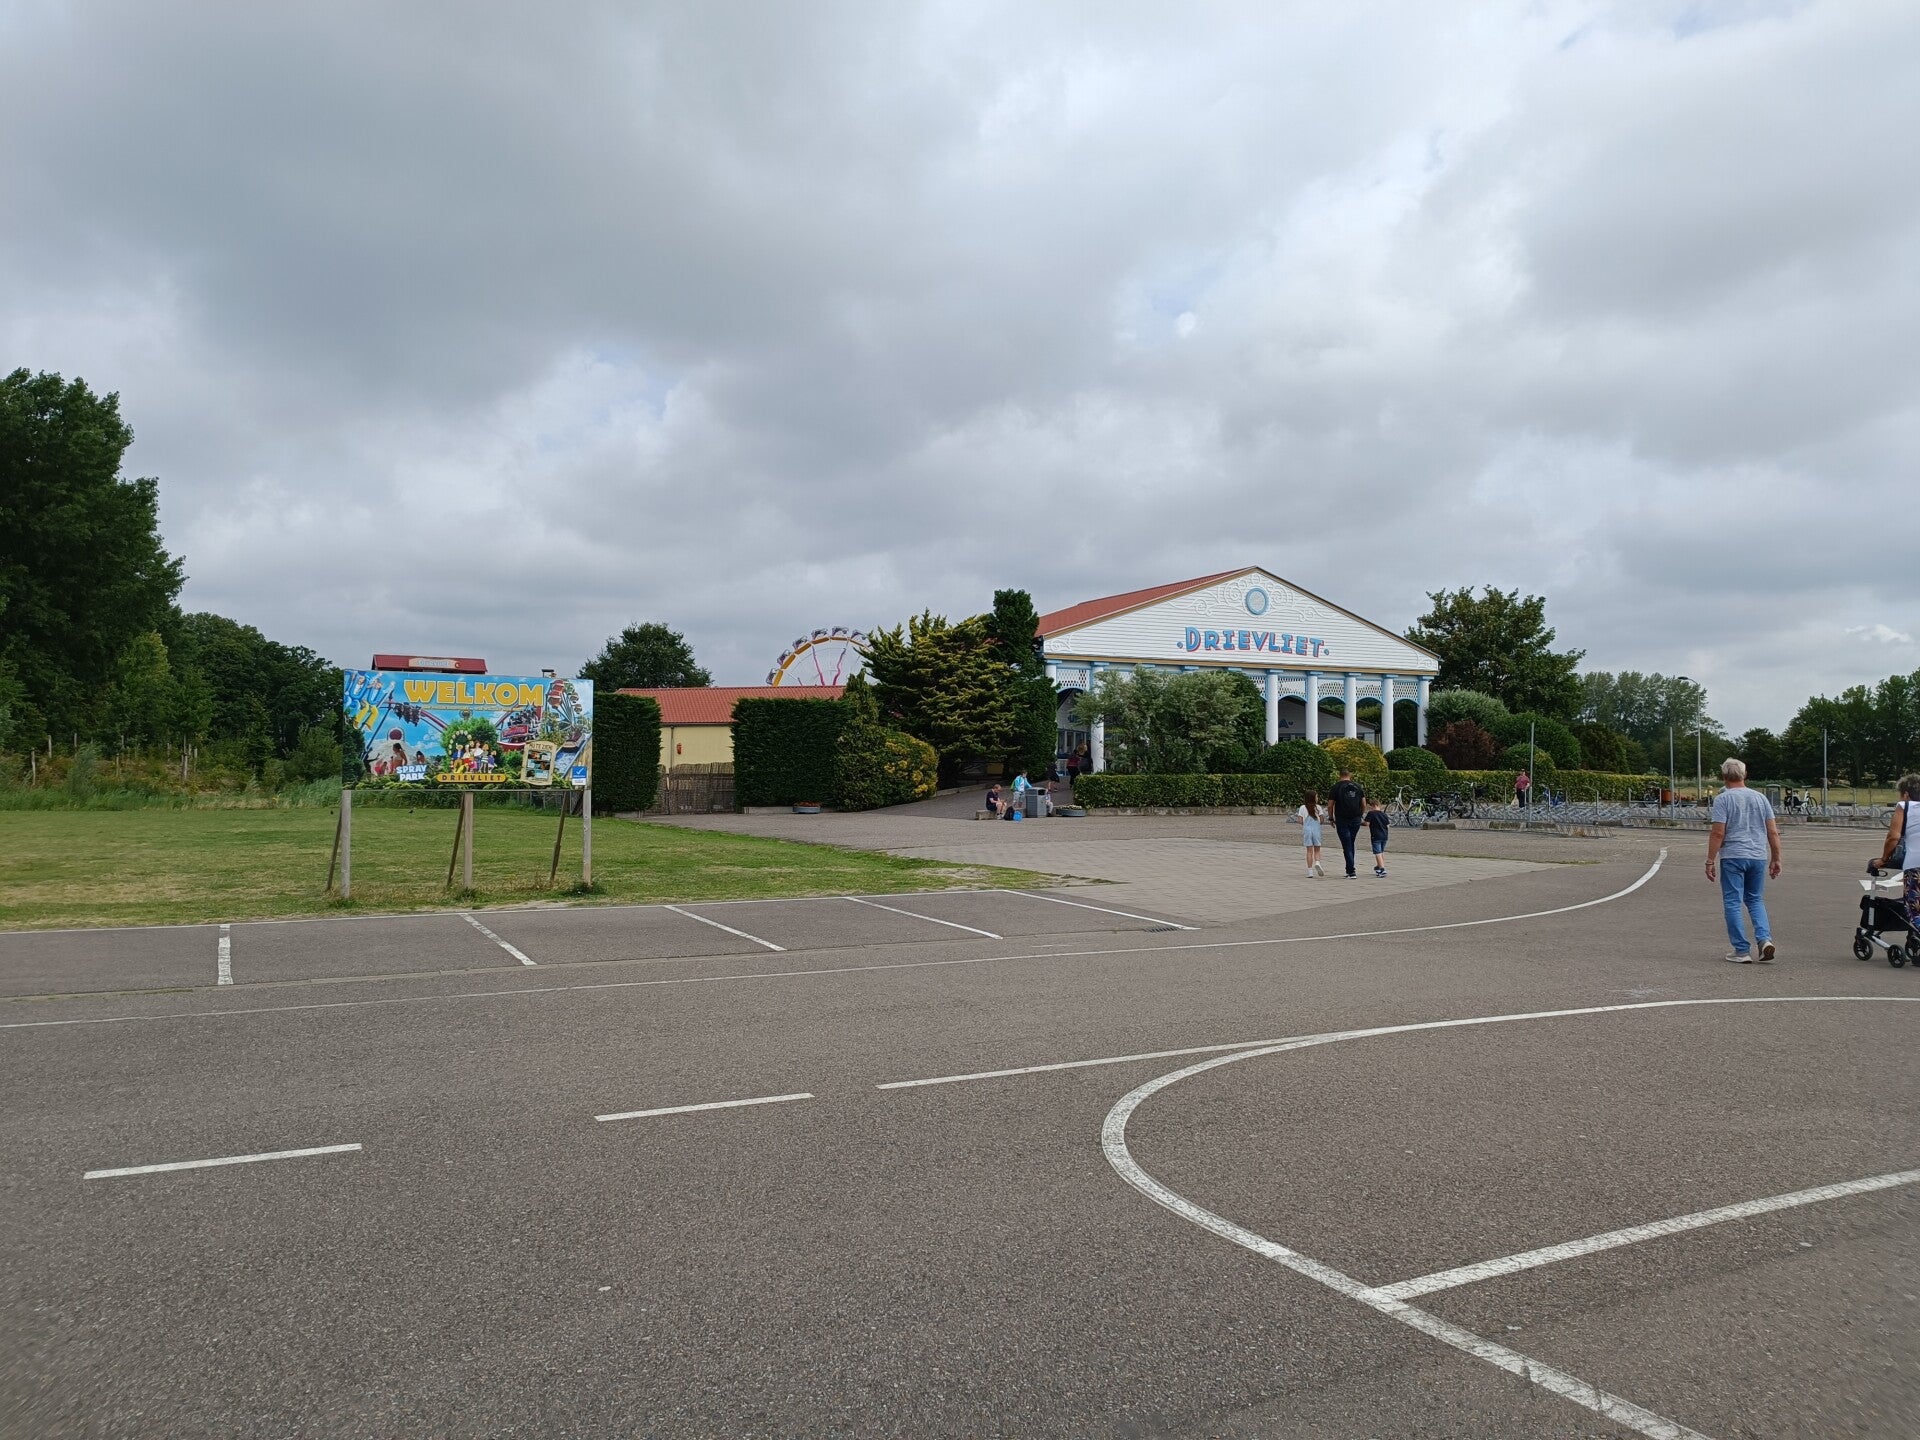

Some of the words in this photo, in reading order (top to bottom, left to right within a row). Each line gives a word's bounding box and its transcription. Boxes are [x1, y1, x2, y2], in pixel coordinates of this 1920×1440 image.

[1185, 626, 1325, 658] DRIEVLIET
[403, 679, 543, 706] WELKOM
[395, 764, 427, 774] SPRAY
[399, 773, 426, 782] PARK
